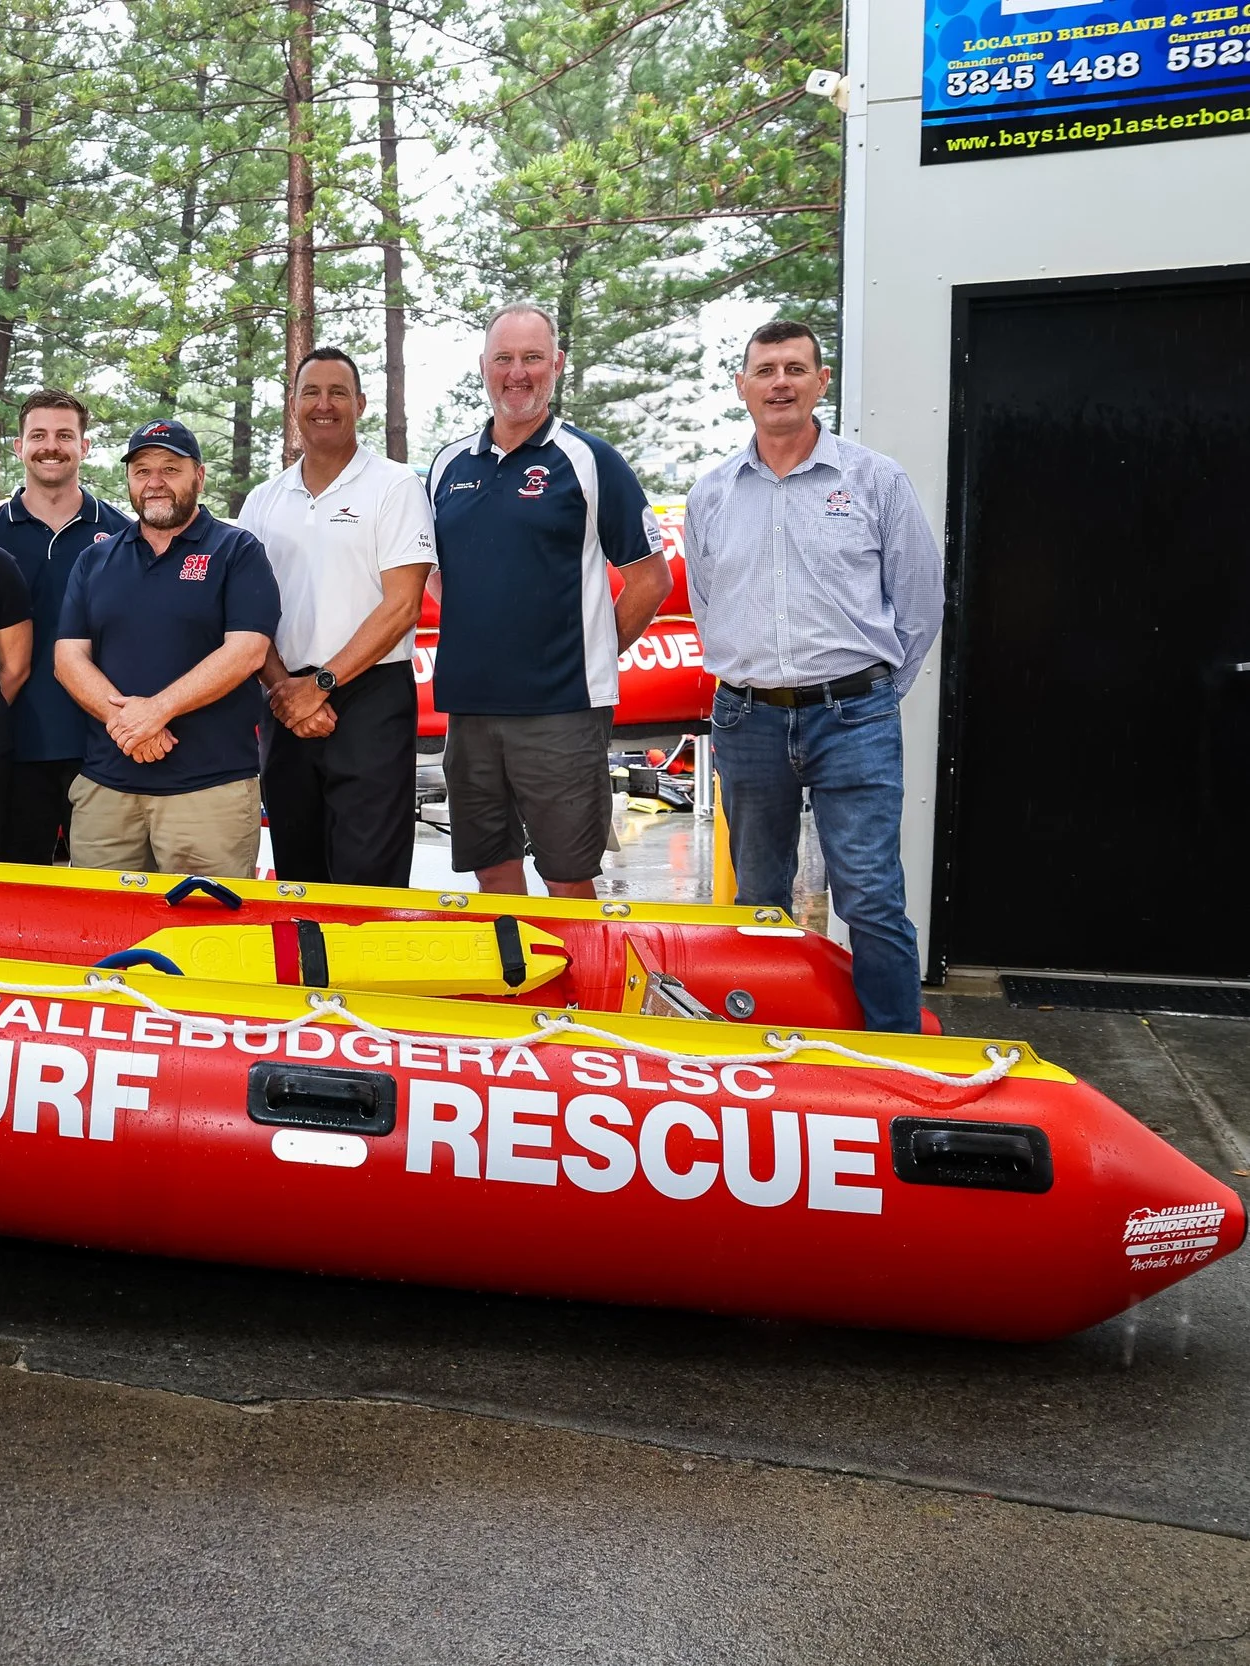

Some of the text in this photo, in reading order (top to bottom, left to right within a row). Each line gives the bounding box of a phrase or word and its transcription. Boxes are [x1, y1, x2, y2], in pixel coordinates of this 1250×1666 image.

[963, 31, 1053, 52] LOCATED
[1056, 16, 1166, 42] BRISBANE
[1170, 14, 1188, 27] &
[1191, 6, 1239, 24] THE
[1168, 29, 1226, 43] Carrara
[947, 51, 1044, 70] Chandler Office
[1166, 39, 1250, 71] 552
[947, 52, 1140, 97] 3245 4488
[183, 554, 211, 570] SH
[179, 569, 206, 581] SLSC
[360, 940, 496, 962] RESCUE
[571, 1050, 777, 1101] SLSC
[405, 1079, 884, 1216] RESCUE
[1122, 1214, 1225, 1243] THUNDERCAT
[1129, 1227, 1220, 1242] INFLATABLES
